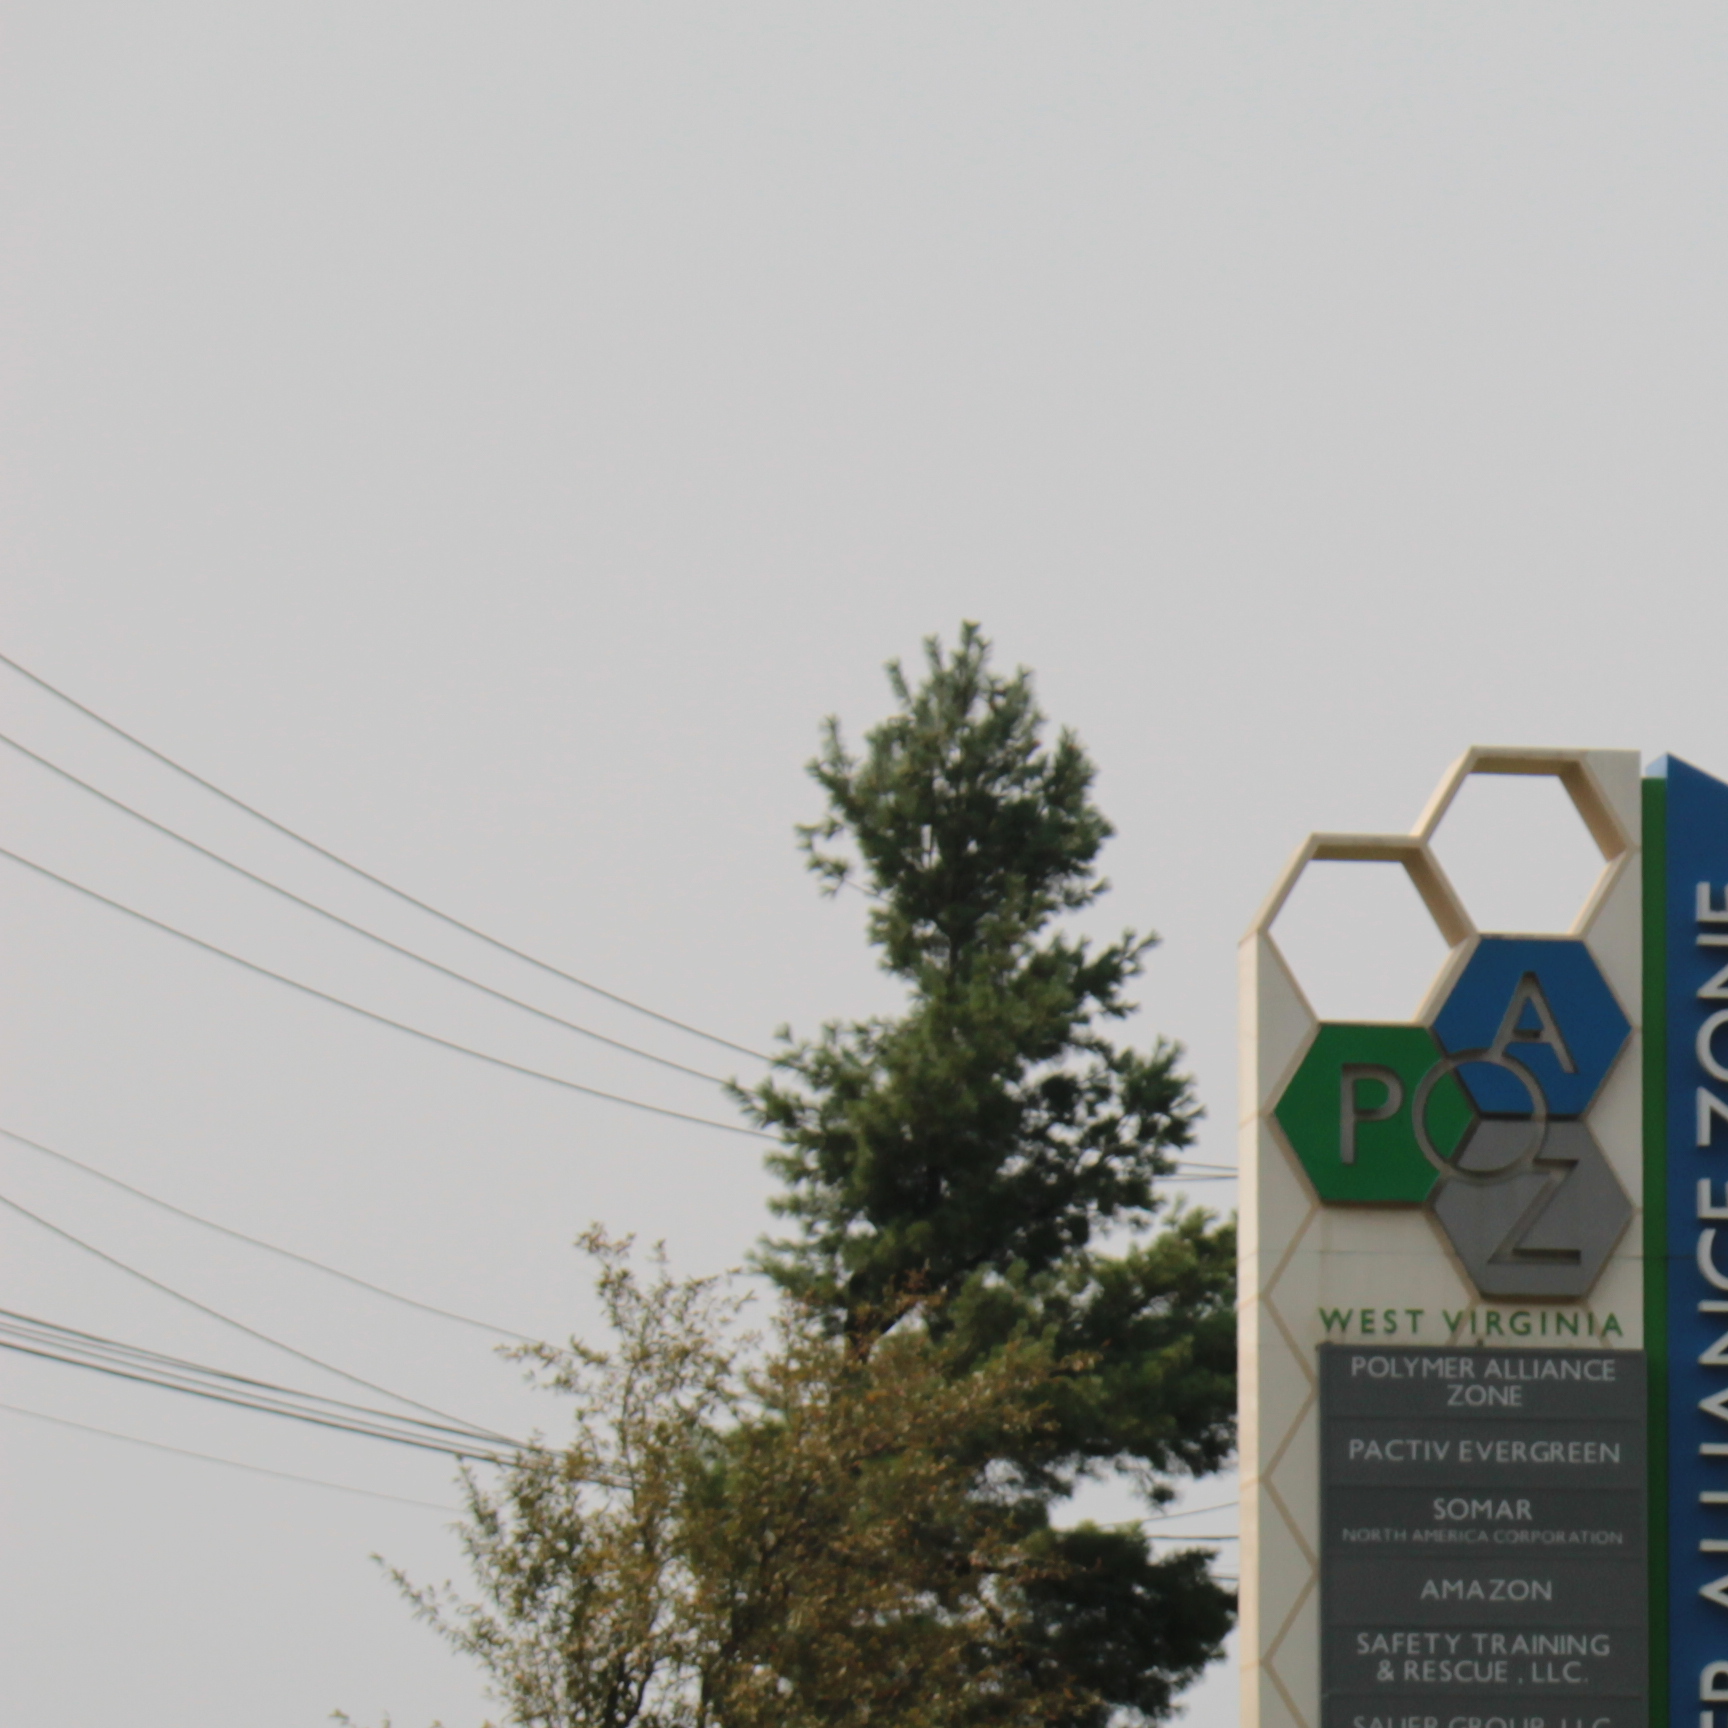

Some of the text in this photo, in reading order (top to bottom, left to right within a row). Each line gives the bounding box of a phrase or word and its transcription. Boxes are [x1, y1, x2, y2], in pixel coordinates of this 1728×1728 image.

[1319, 1307, 1623, 1337] WEST VIRGINIA
[1351, 1356, 1616, 1382] POLYMER ALLIANCE
[1446, 1384, 1523, 1407] ZONE
[1349, 1438, 1621, 1463] PACTIV EVERGREEN
[1433, 1497, 1533, 1521] SOMAR
[1342, 1528, 1623, 1545] NORTH AMERICA CORPORATION
[1420, 1578, 1553, 1601] AMAZON
[1356, 1632, 1611, 1657] SAFETY TRAINING
[1376, 1659, 1394, 1682] &
[1531, 1661, 1589, 1684] LLC.
